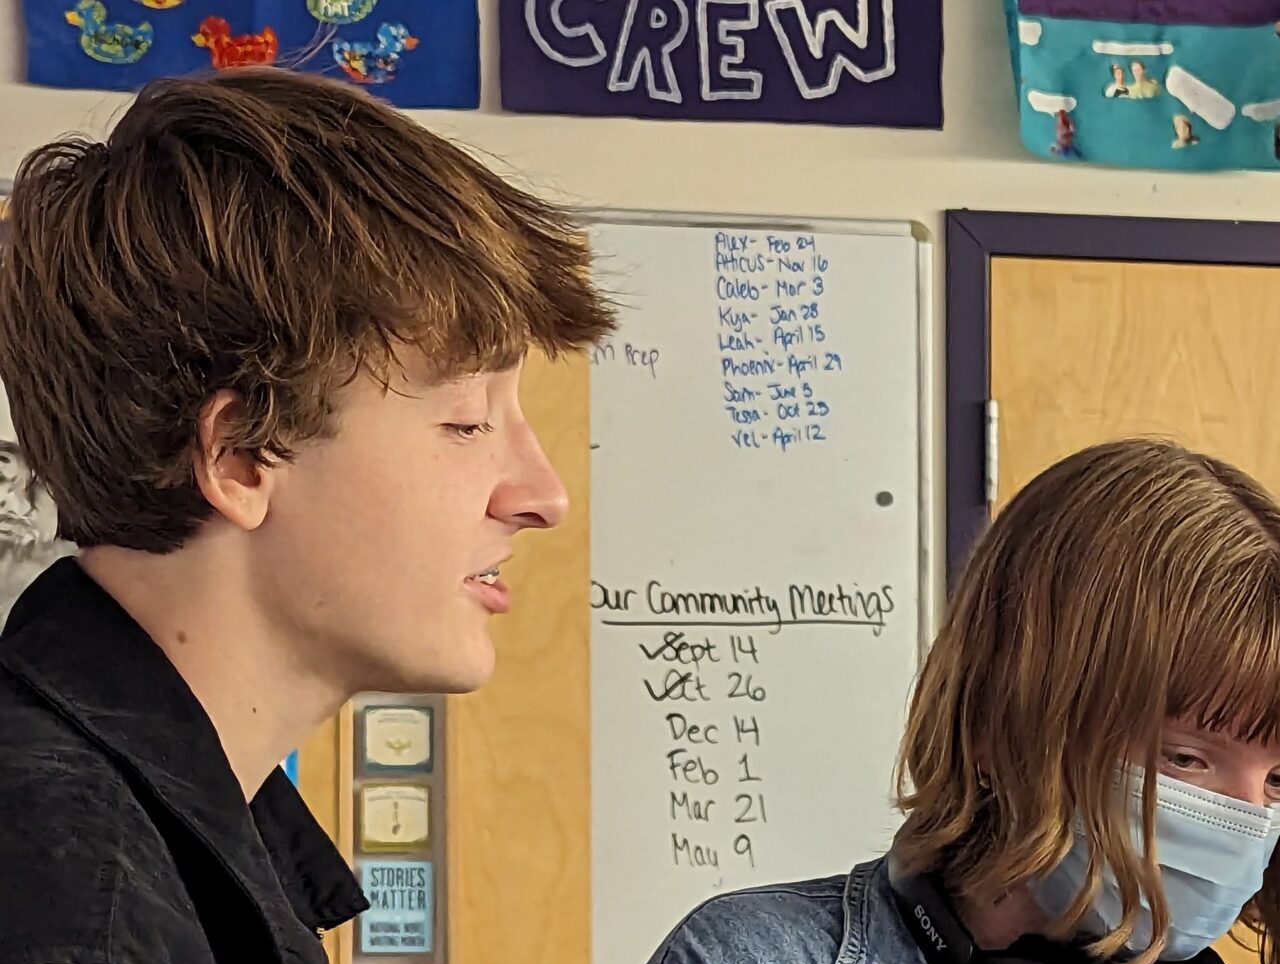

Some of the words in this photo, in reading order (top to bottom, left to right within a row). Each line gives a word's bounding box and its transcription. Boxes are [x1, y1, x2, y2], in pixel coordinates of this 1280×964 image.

[526, 0, 897, 102] CREW
[767, 235, 790, 253] Feb
[796, 235, 815, 252] 24
[779, 258, 804, 272] Nov
[813, 254, 828, 272] 16
[812, 276, 824, 296] 3
[771, 305, 797, 324] Jan
[774, 326, 804, 352] April
[808, 324, 825, 342] 15
[788, 354, 817, 379] April
[767, 384, 796, 401] June
[778, 403, 800, 420] Oct
[772, 426, 801, 452] April
[806, 424, 826, 441] 12
[590, 580, 638, 609] Our
[648, 580, 782, 634] Community
[789, 583, 895, 637] Meetings
[663, 632, 720, 668] Sept
[730, 635, 759, 663] 14
[664, 669, 711, 701] Oct
[727, 672, 766, 701] 26
[666, 713, 719, 744] Dec
[733, 716, 760, 746] 14
[667, 748, 719, 785] Feb
[738, 753, 762, 783] 1
[669, 791, 715, 821] Mar
[734, 794, 767, 824] 21
[733, 833, 755, 867] 9
[371, 867, 426, 888] STORIES
[370, 889, 426, 910] MATTER
[914, 904, 948, 952] SONY
